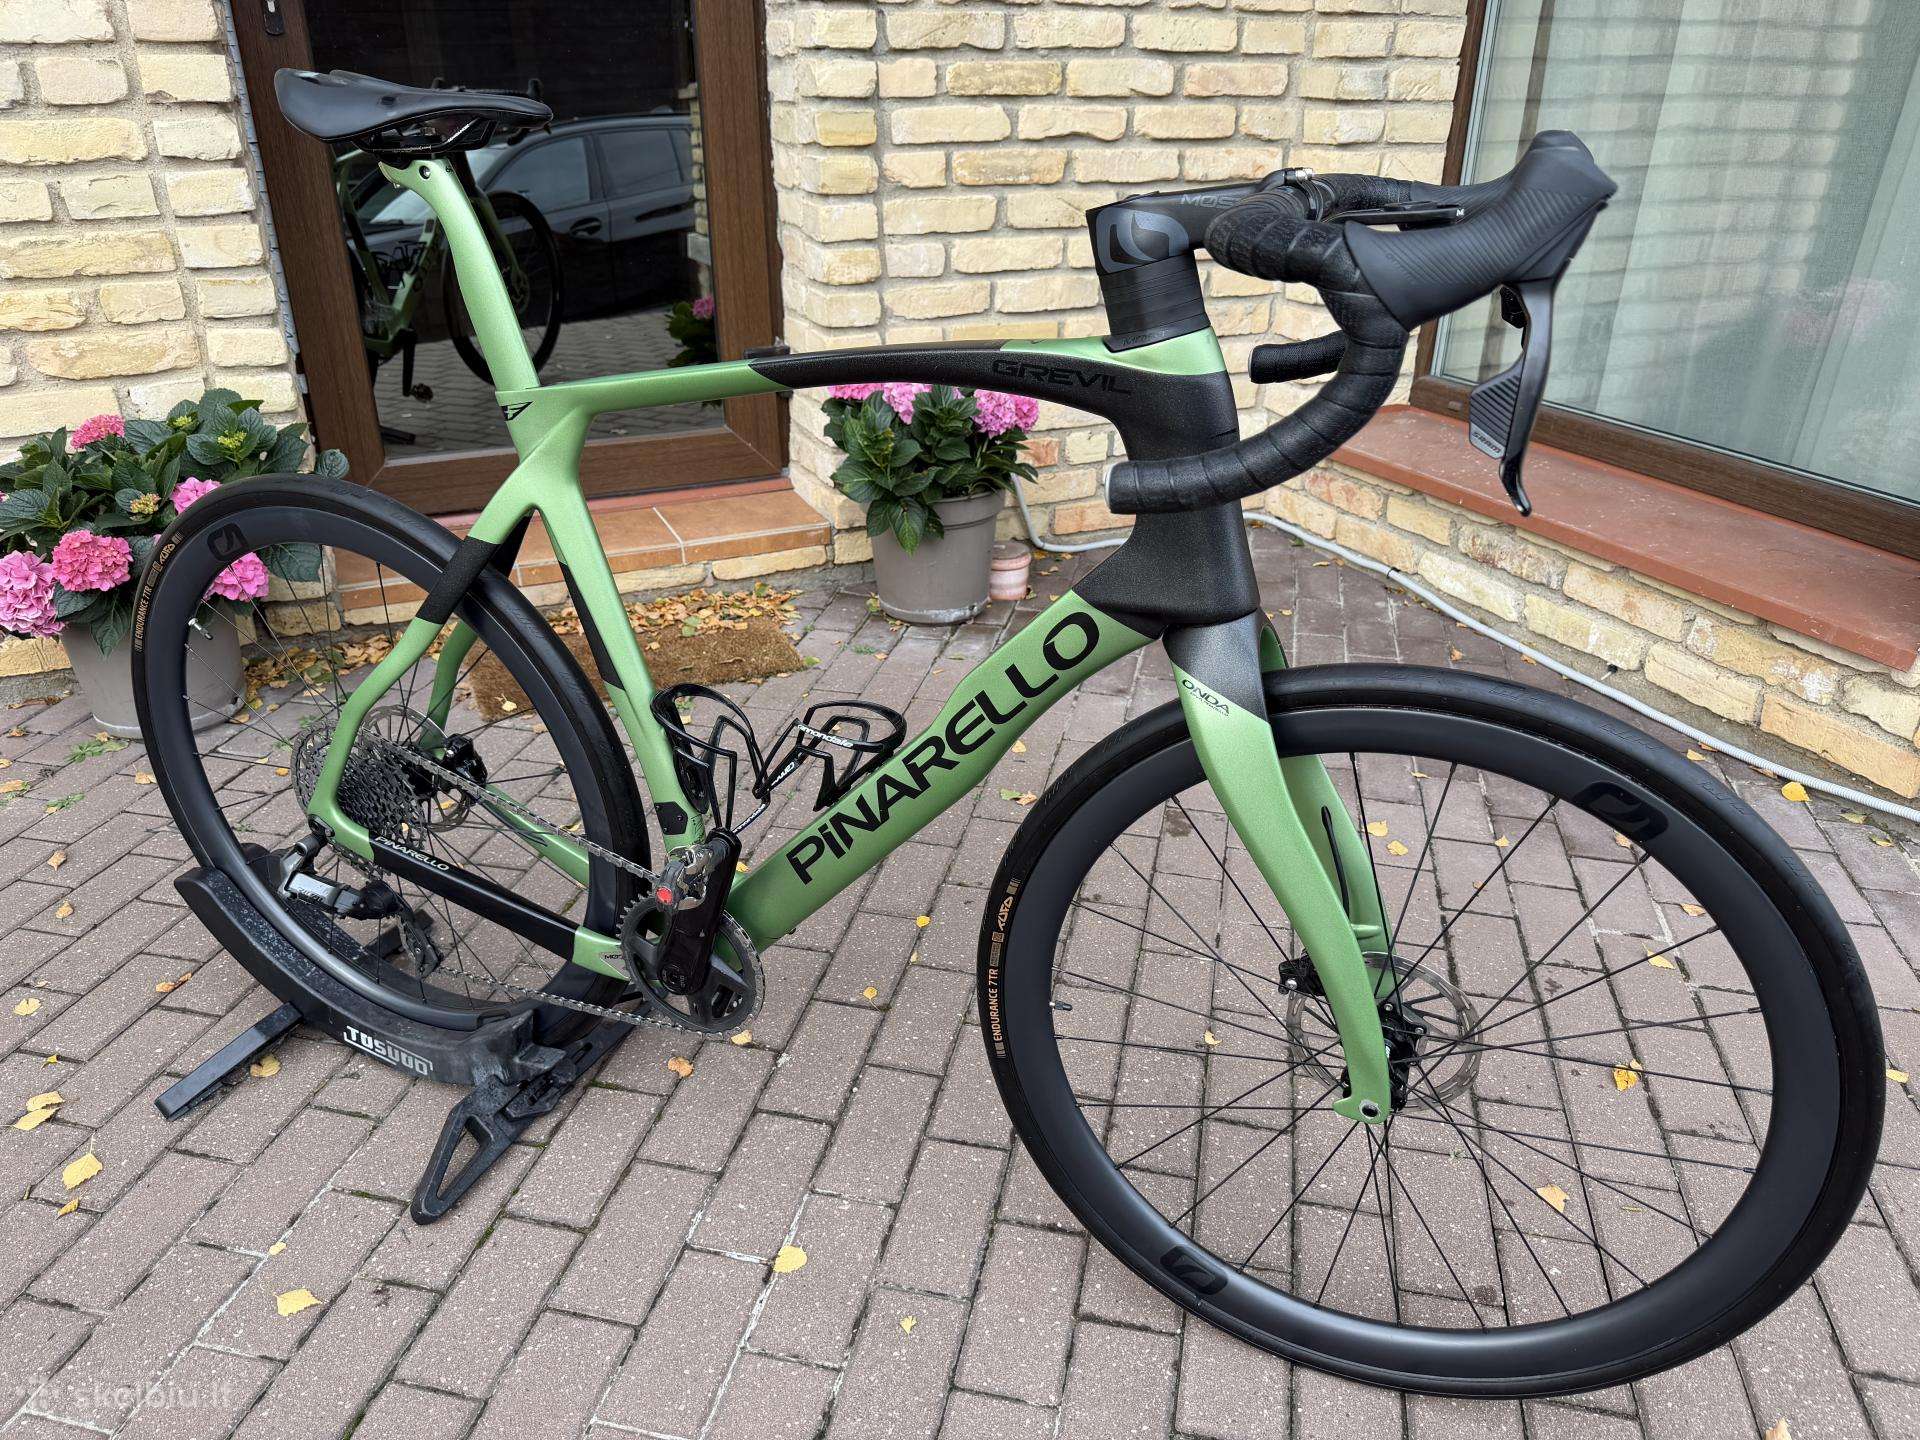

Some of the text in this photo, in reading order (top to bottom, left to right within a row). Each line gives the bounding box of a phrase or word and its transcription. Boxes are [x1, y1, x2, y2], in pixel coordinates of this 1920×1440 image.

[992, 359, 1132, 396] GREVIL
[1182, 679, 1230, 715] ONDA
[374, 836, 450, 871] PINARELLO
[988, 968, 999, 986] 7TR
[988, 988, 1003, 1042] ENDURANCE
